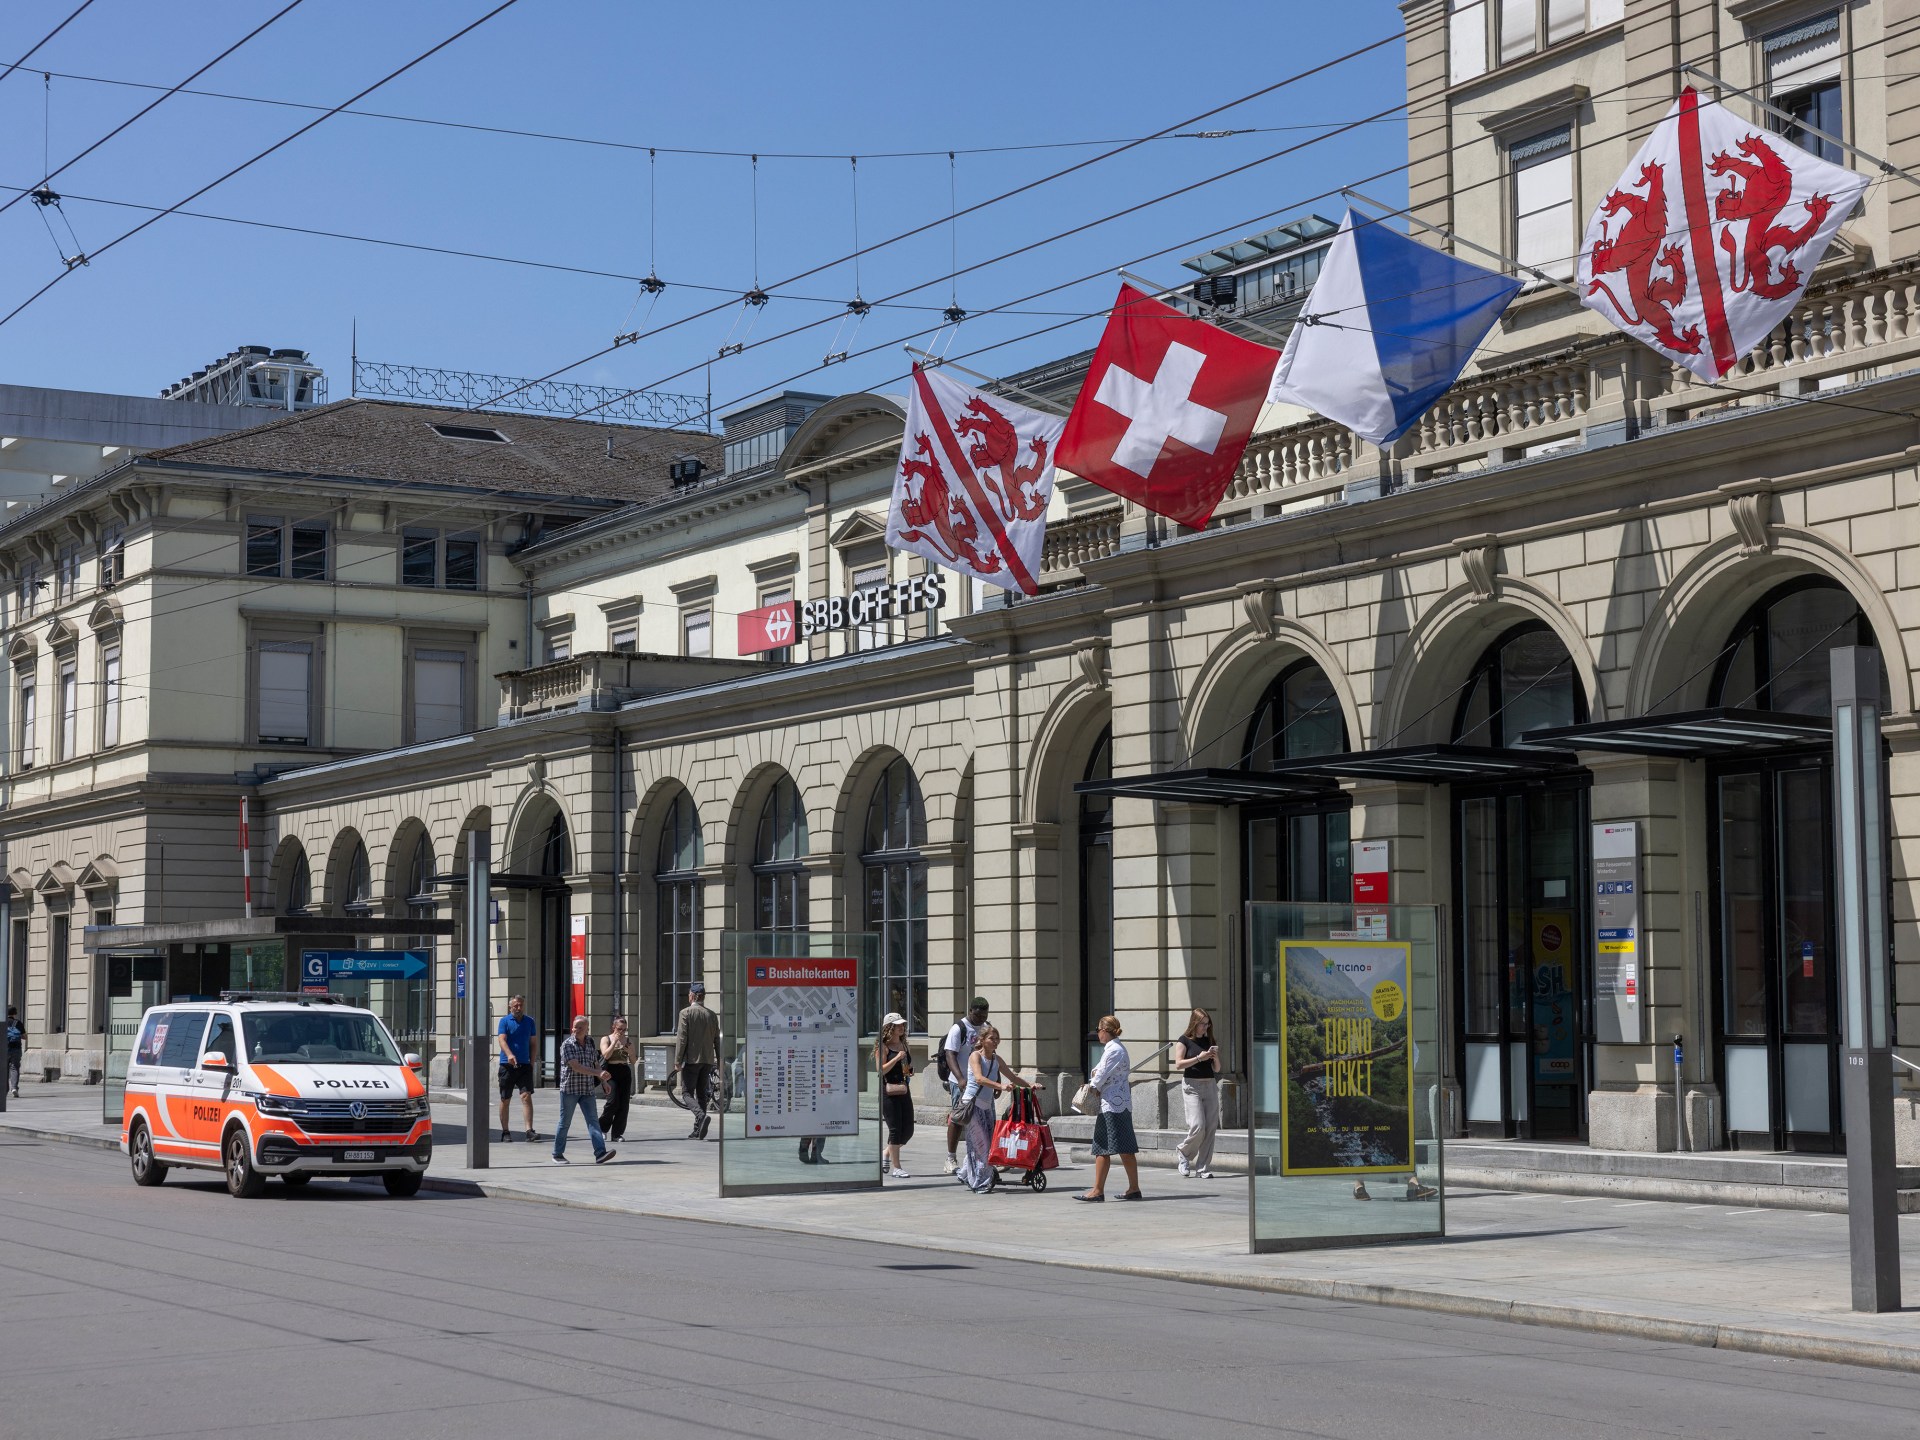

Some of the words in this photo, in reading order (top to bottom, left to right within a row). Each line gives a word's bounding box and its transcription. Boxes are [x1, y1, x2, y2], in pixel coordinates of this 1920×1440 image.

[802, 596, 842, 636] SBB
[849, 584, 890, 626] CFF
[896, 573, 939, 615] FFS
[308, 959, 323, 976] G
[768, 967, 850, 979] Bushaltekanten
[1323, 1017, 1372, 1055] TICINO
[232, 1077, 242, 1089] 201
[313, 1080, 390, 1089] POLIZEI
[1323, 1060, 1373, 1097] TICKET
[193, 1105, 221, 1123] POLIZEI
